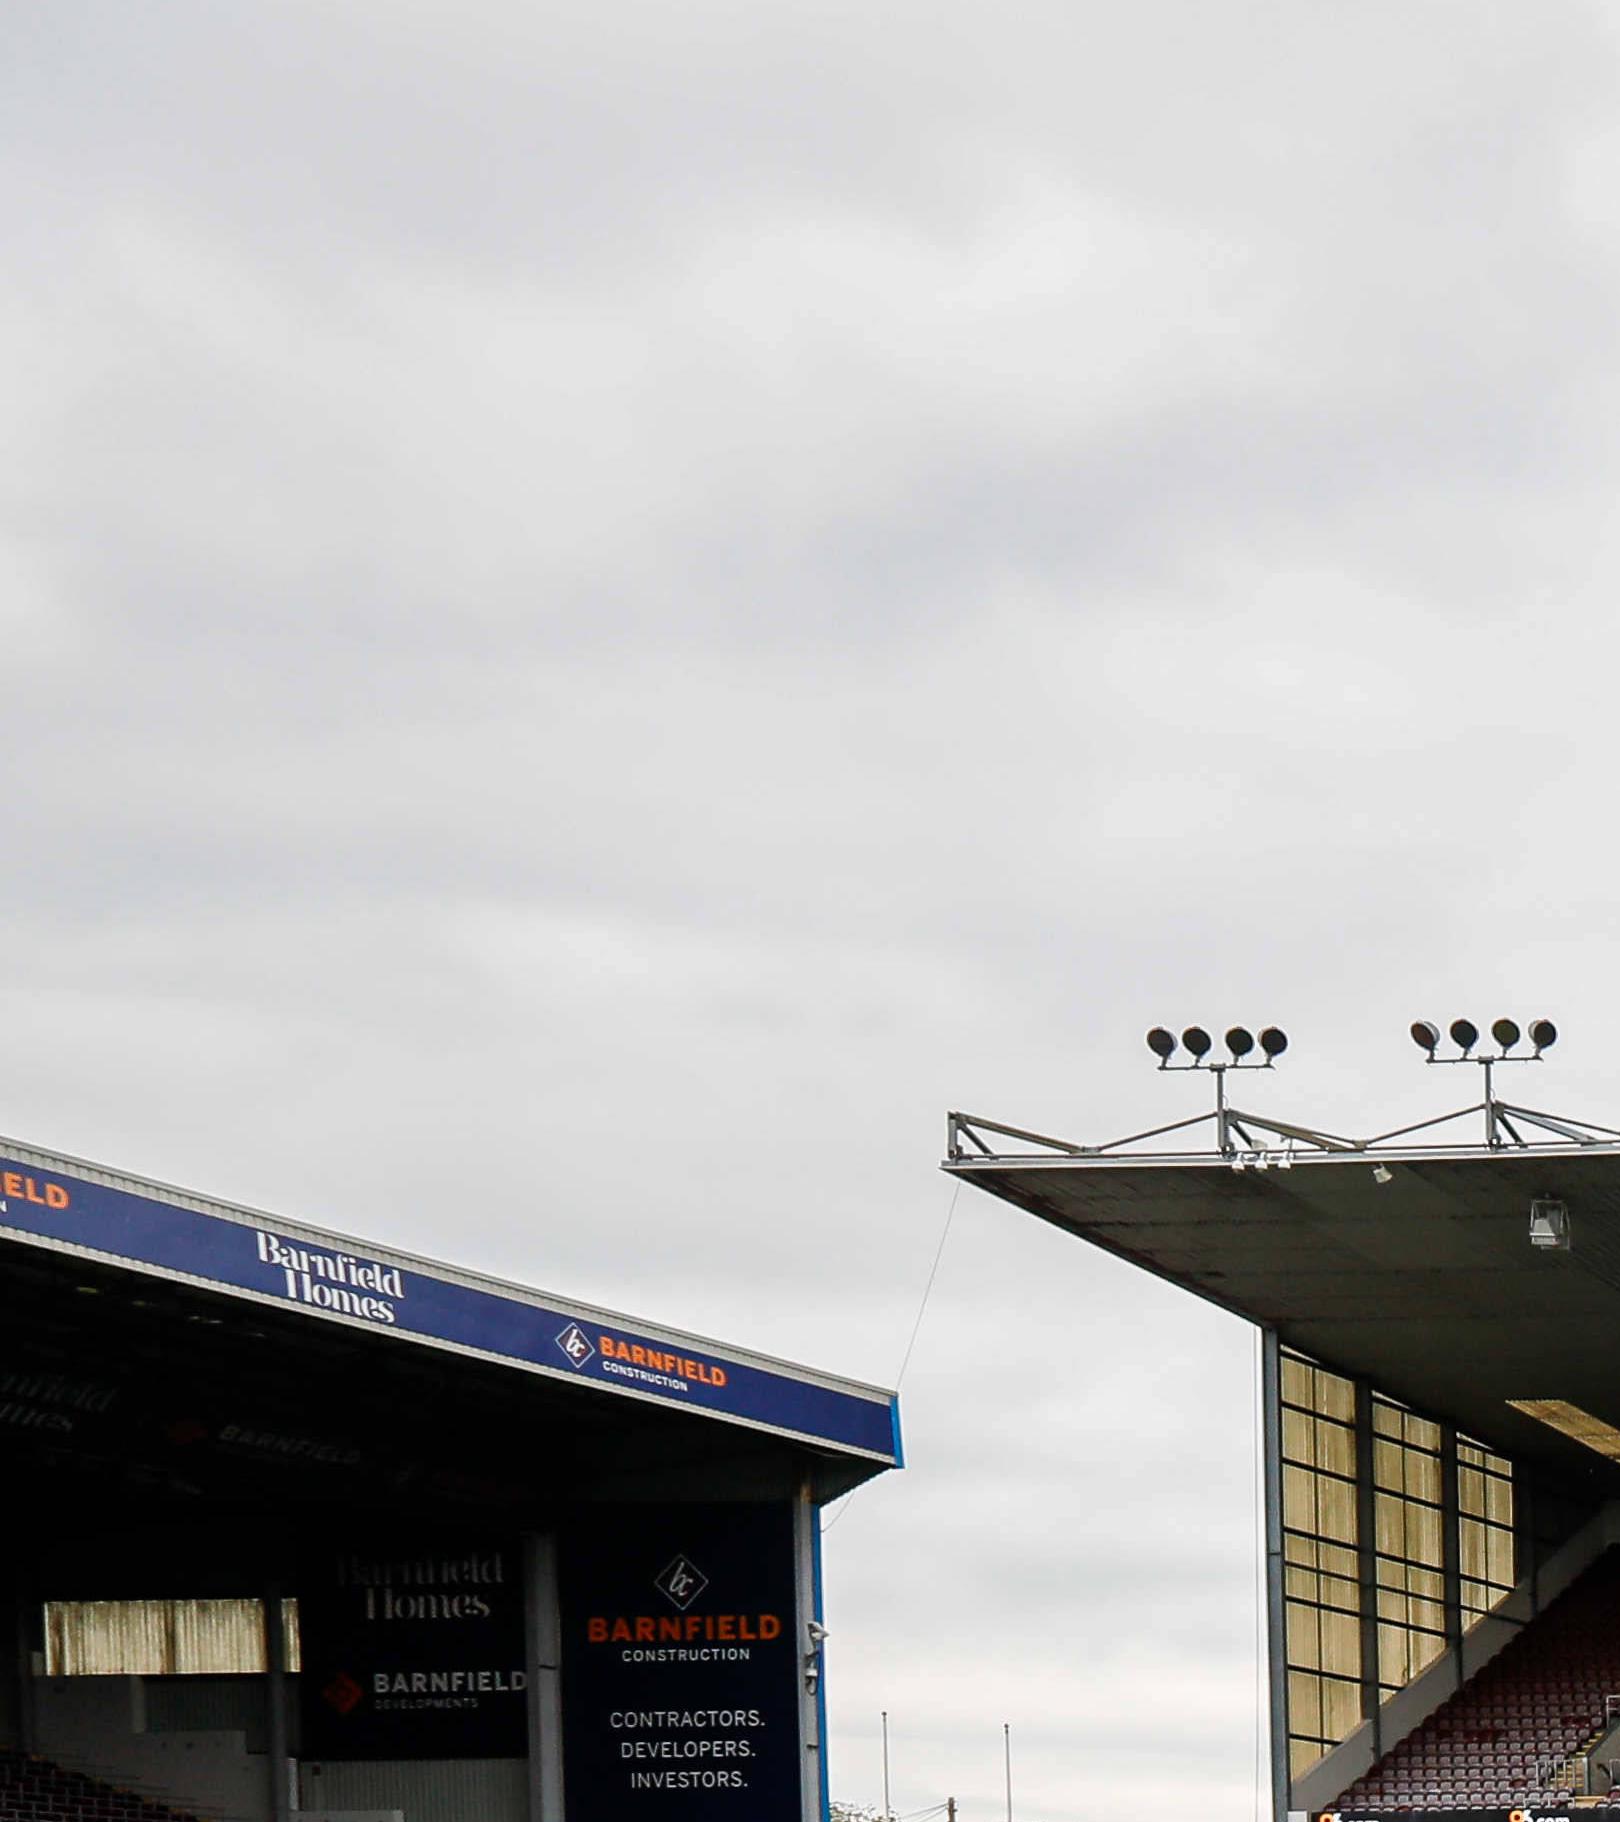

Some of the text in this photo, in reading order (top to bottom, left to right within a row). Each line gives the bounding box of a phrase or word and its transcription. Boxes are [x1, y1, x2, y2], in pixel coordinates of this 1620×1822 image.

[257, 1231, 404, 1299] Barnfield
[285, 1269, 395, 1324] Homes
[600, 1335, 728, 1387] BARNFIELD
[602, 1360, 688, 1392] CONSTRUCTION
[587, 1613, 783, 1643] BARNFIELD
[622, 1647, 750, 1663] CONSTRUCTION
[373, 1671, 526, 1693] BARNFIELD
[610, 1710, 766, 1728] CONTRACTORS.
[620, 1740, 756, 1758] DEVELOPERS.
[631, 1771, 748, 1788] INVESTORS.
